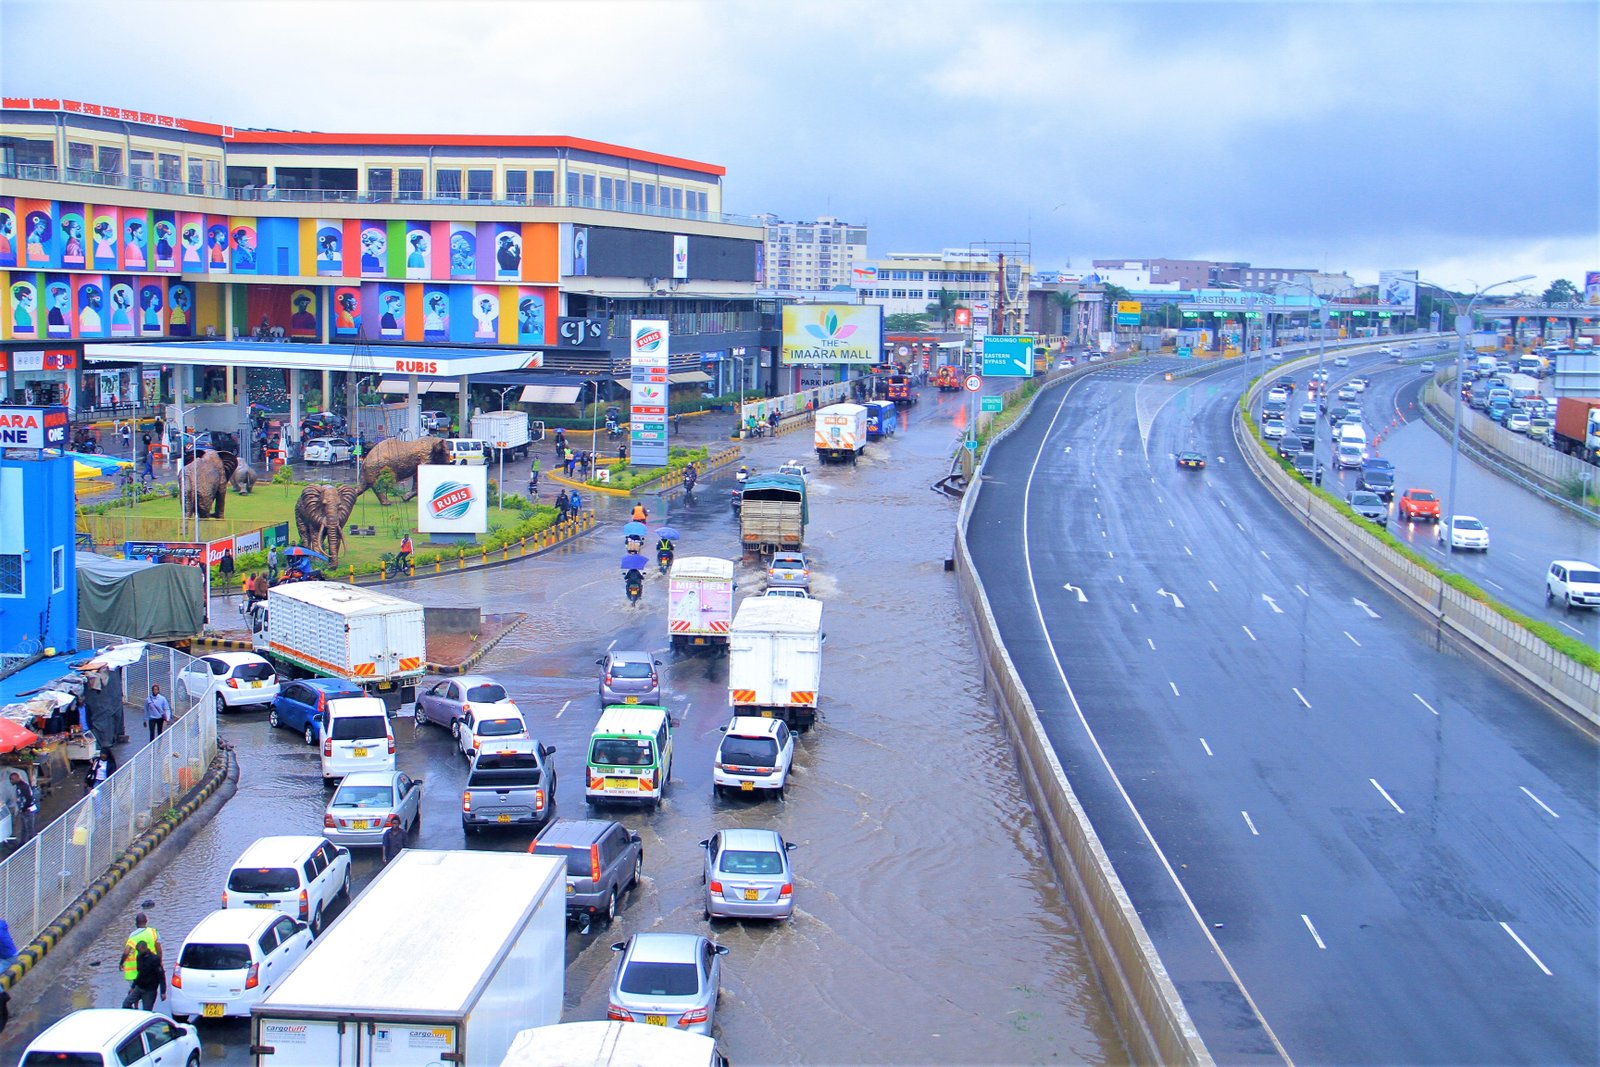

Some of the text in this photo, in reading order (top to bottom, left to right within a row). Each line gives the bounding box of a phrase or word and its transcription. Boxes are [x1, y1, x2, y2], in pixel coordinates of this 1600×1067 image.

[821, 339, 839, 347] THE
[791, 349, 872, 360] IMAARA MALL
[968, 380, 979, 388] 40
[48, 428, 64, 442] ONE
